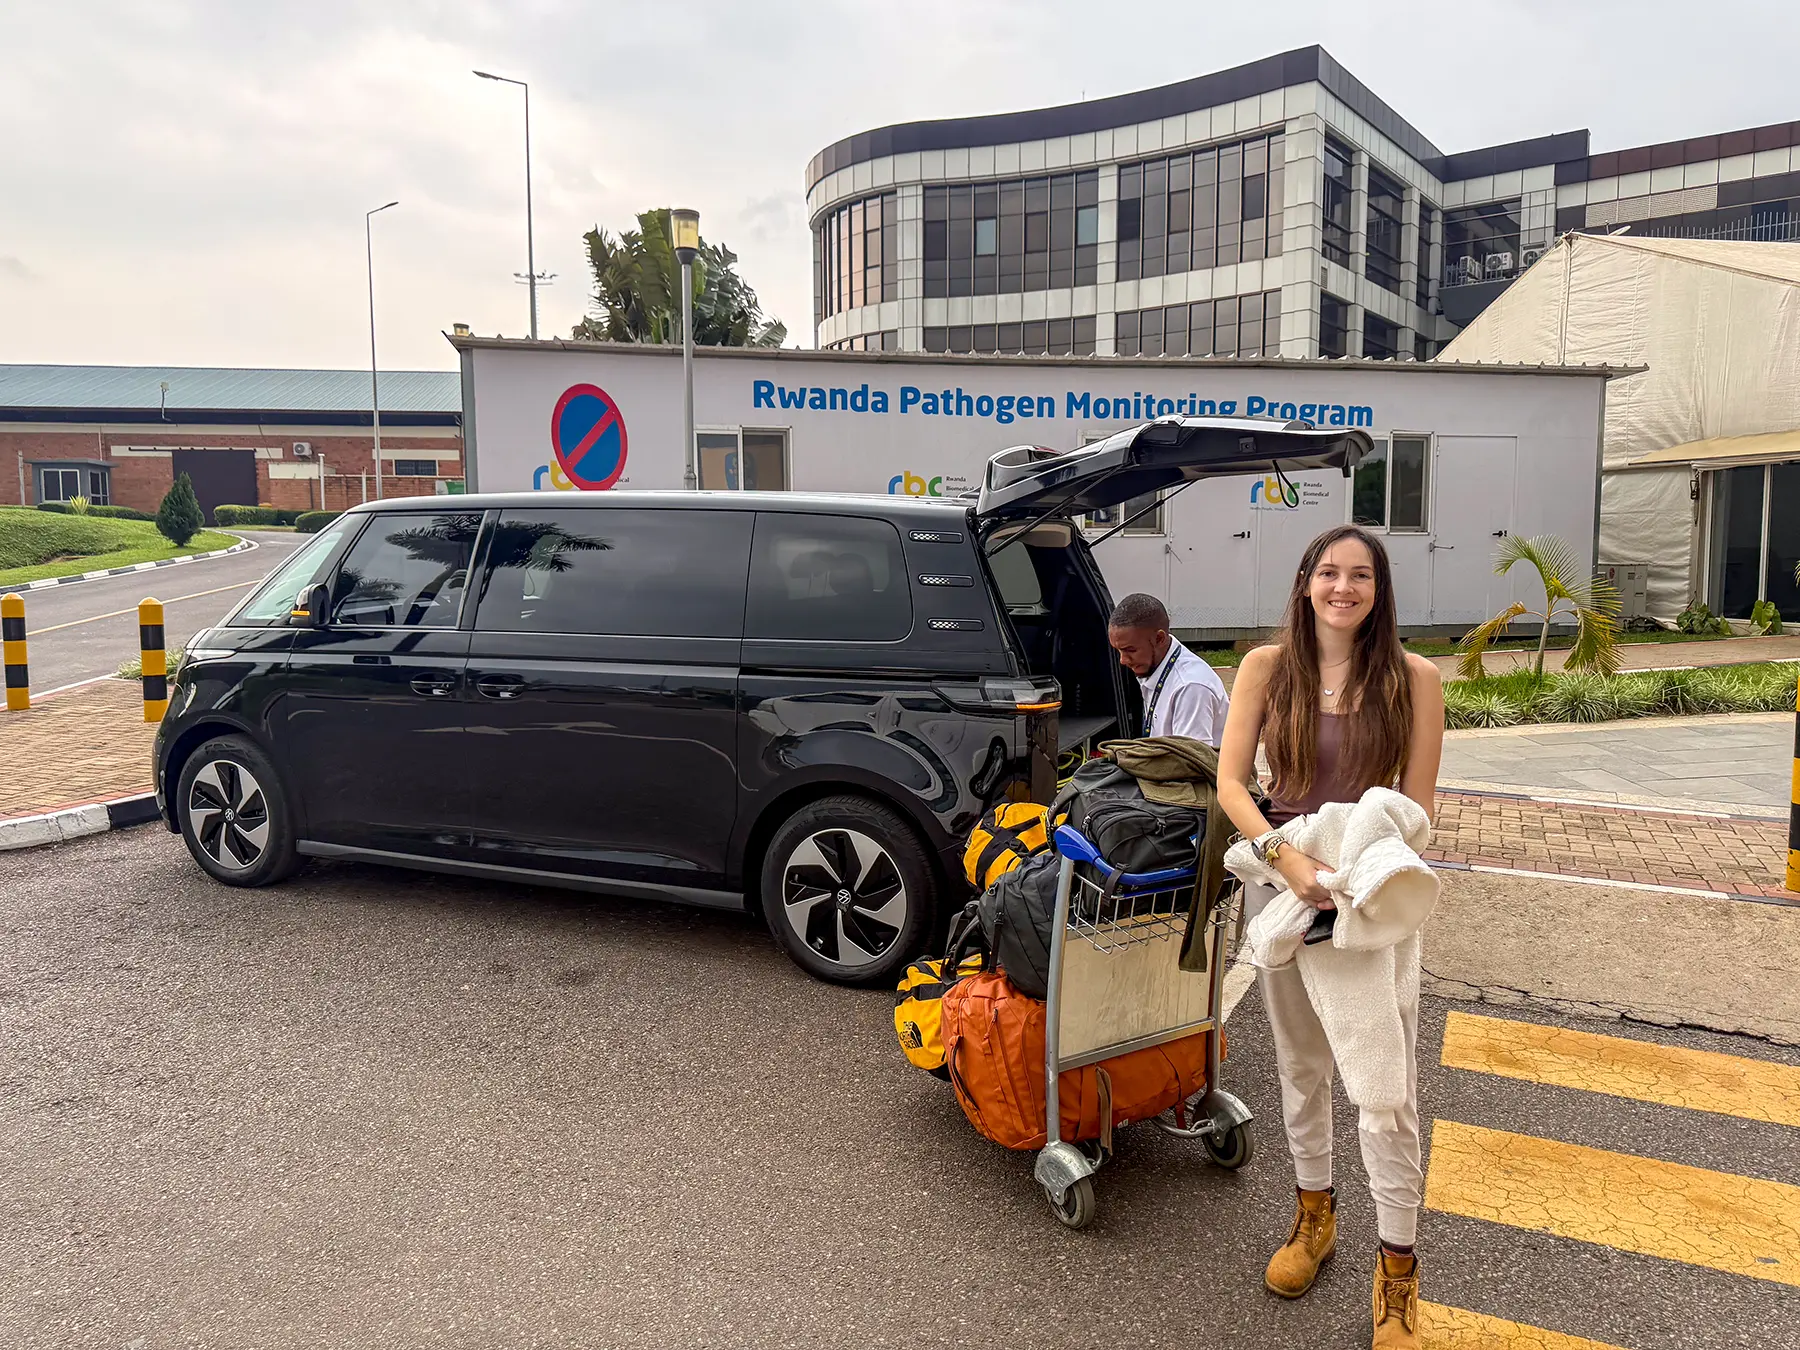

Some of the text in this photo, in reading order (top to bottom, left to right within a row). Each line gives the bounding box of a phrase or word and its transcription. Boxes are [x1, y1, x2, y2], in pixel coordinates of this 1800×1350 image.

[753, 380, 889, 413] Rwanda
[900, 386, 1055, 424] Pathogen
[1246, 396, 1373, 427] Program
[533, 460, 574, 490] rb
[888, 471, 942, 496] rbc
